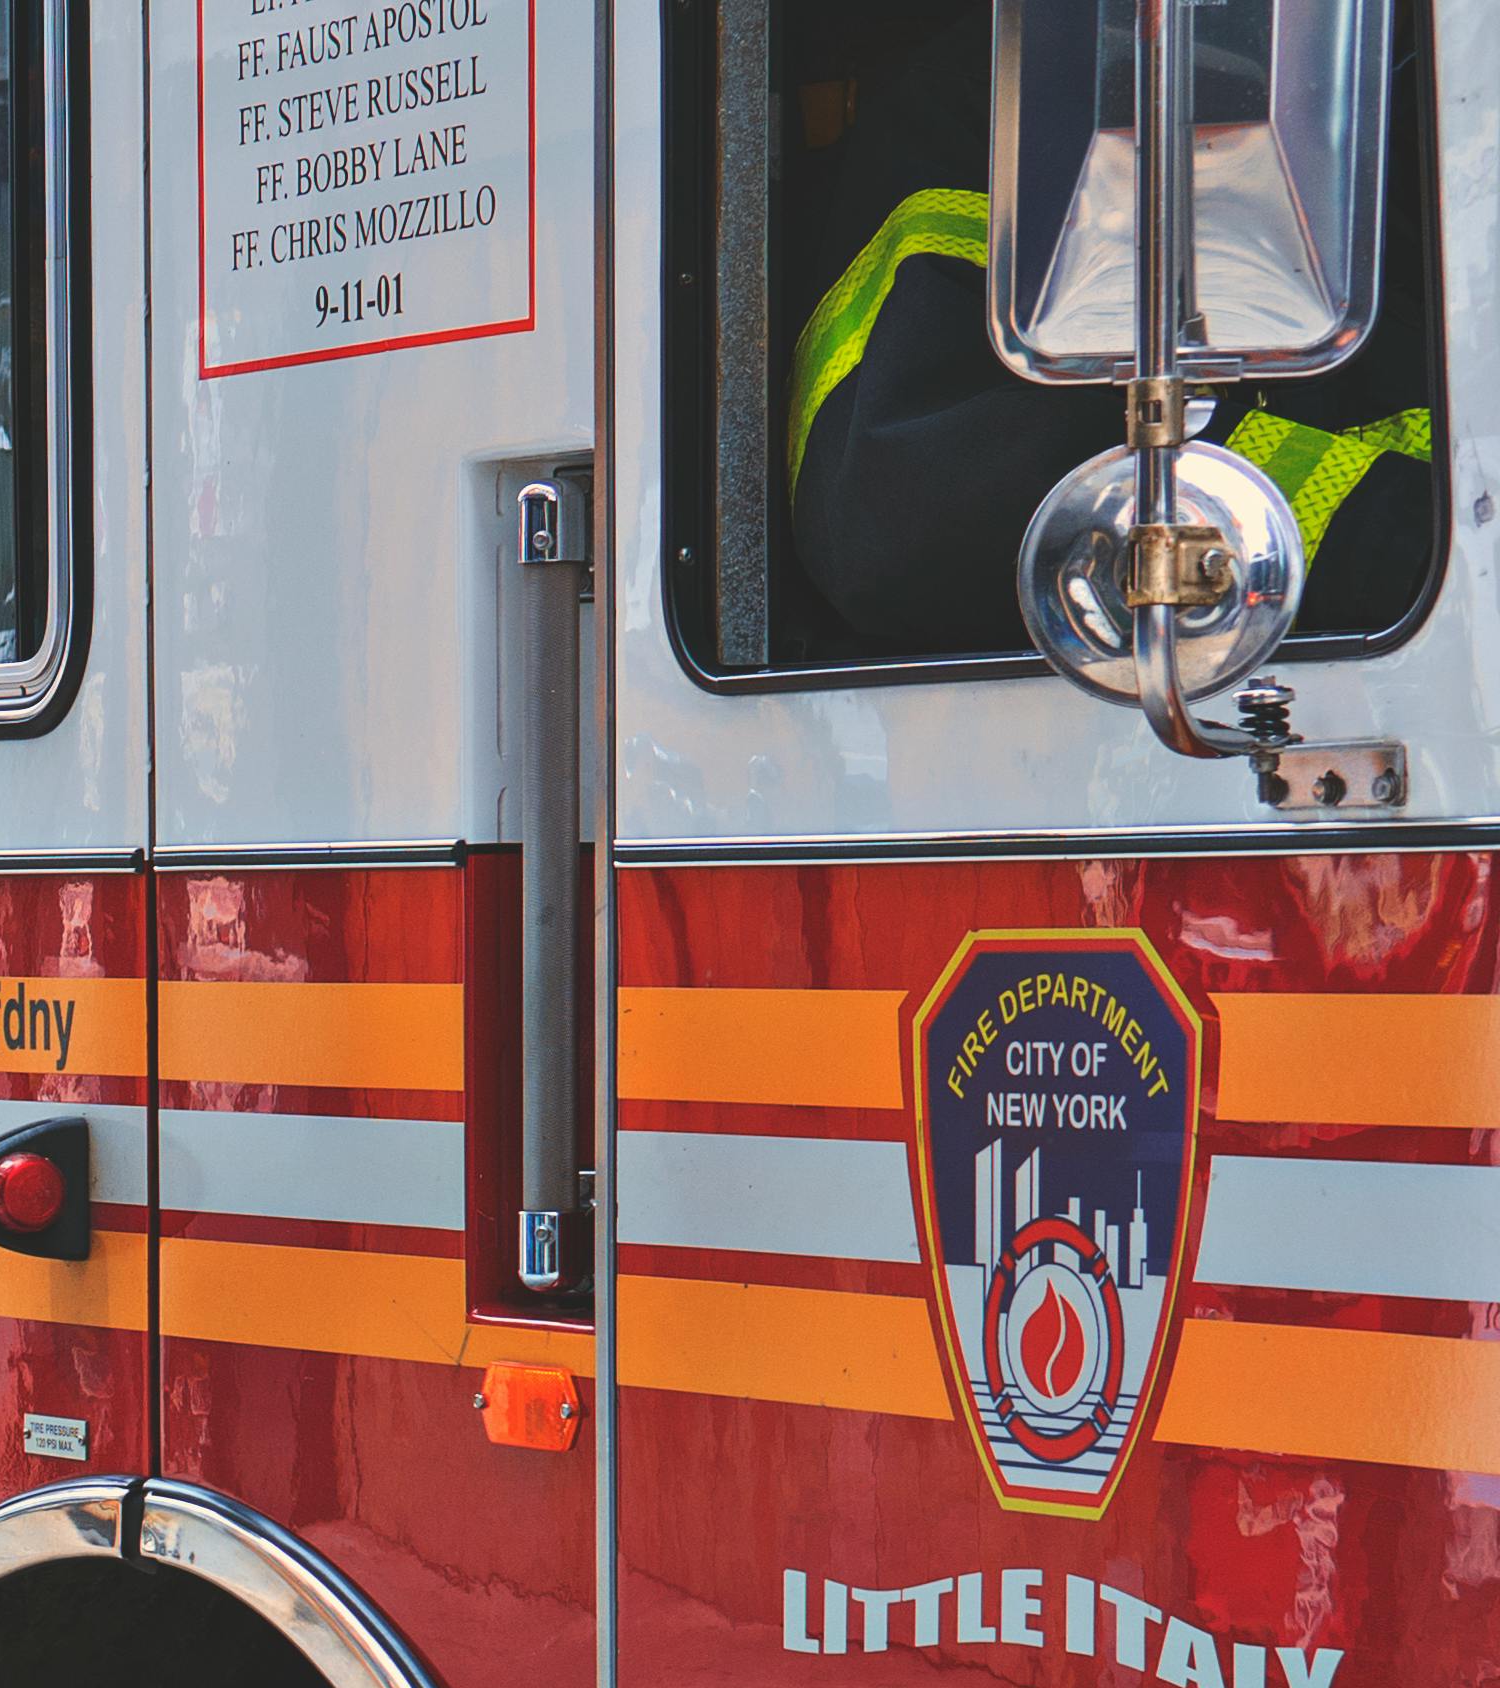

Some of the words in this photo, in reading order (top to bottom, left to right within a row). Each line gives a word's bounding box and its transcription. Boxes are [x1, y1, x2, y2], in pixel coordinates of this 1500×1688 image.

[238, 39, 269, 81] FF.
[277, 16, 358, 72] FAUST
[364, 0, 488, 52] APOSTOL
[239, 104, 270, 145] FF.
[278, 83, 359, 137] STEVE
[367, 56, 487, 118] RUSSELL
[257, 163, 288, 204] FF.
[296, 141, 387, 196] BOBBY
[394, 125, 467, 177] LANE
[232, 231, 263, 271] FF.
[271, 213, 347, 263] CHRIS
[355, 185, 496, 248] MOZZILLO
[315, 272, 404, 329] 9-11-01
[947, 1010, 998, 1099] FIRE
[998, 973, 1169, 1098] DEPARTMENT
[1006, 1041, 1065, 1076] CITY
[1071, 1042, 1108, 1077] OF
[987, 1092, 1046, 1128] NEW
[1052, 1094, 1127, 1130] YORK
[30, 1421, 44, 1434] TIRE
[45, 1423, 79, 1438] PRESSURE
[783, 1568, 1045, 1655] LITTLE
